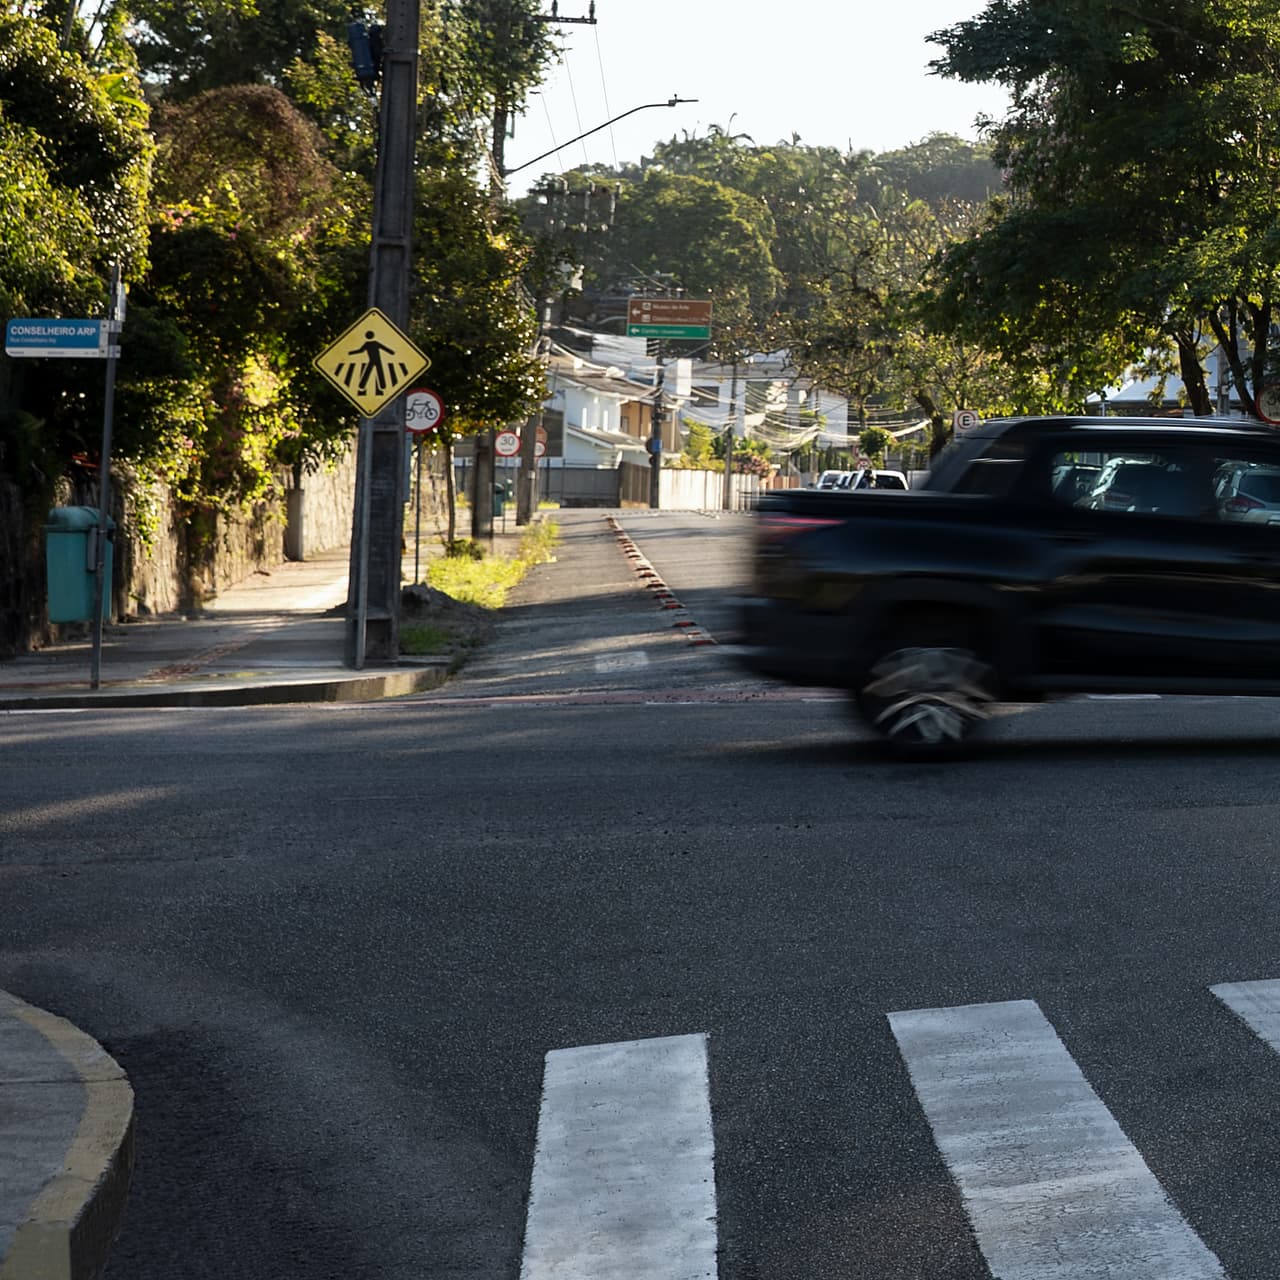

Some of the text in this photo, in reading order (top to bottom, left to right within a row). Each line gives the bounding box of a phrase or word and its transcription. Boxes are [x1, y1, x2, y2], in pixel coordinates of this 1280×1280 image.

[10, 326, 97, 336] CONSELHEIRO ARP
[962, 415, 971, 426] E
[500, 435, 516, 446] 30
